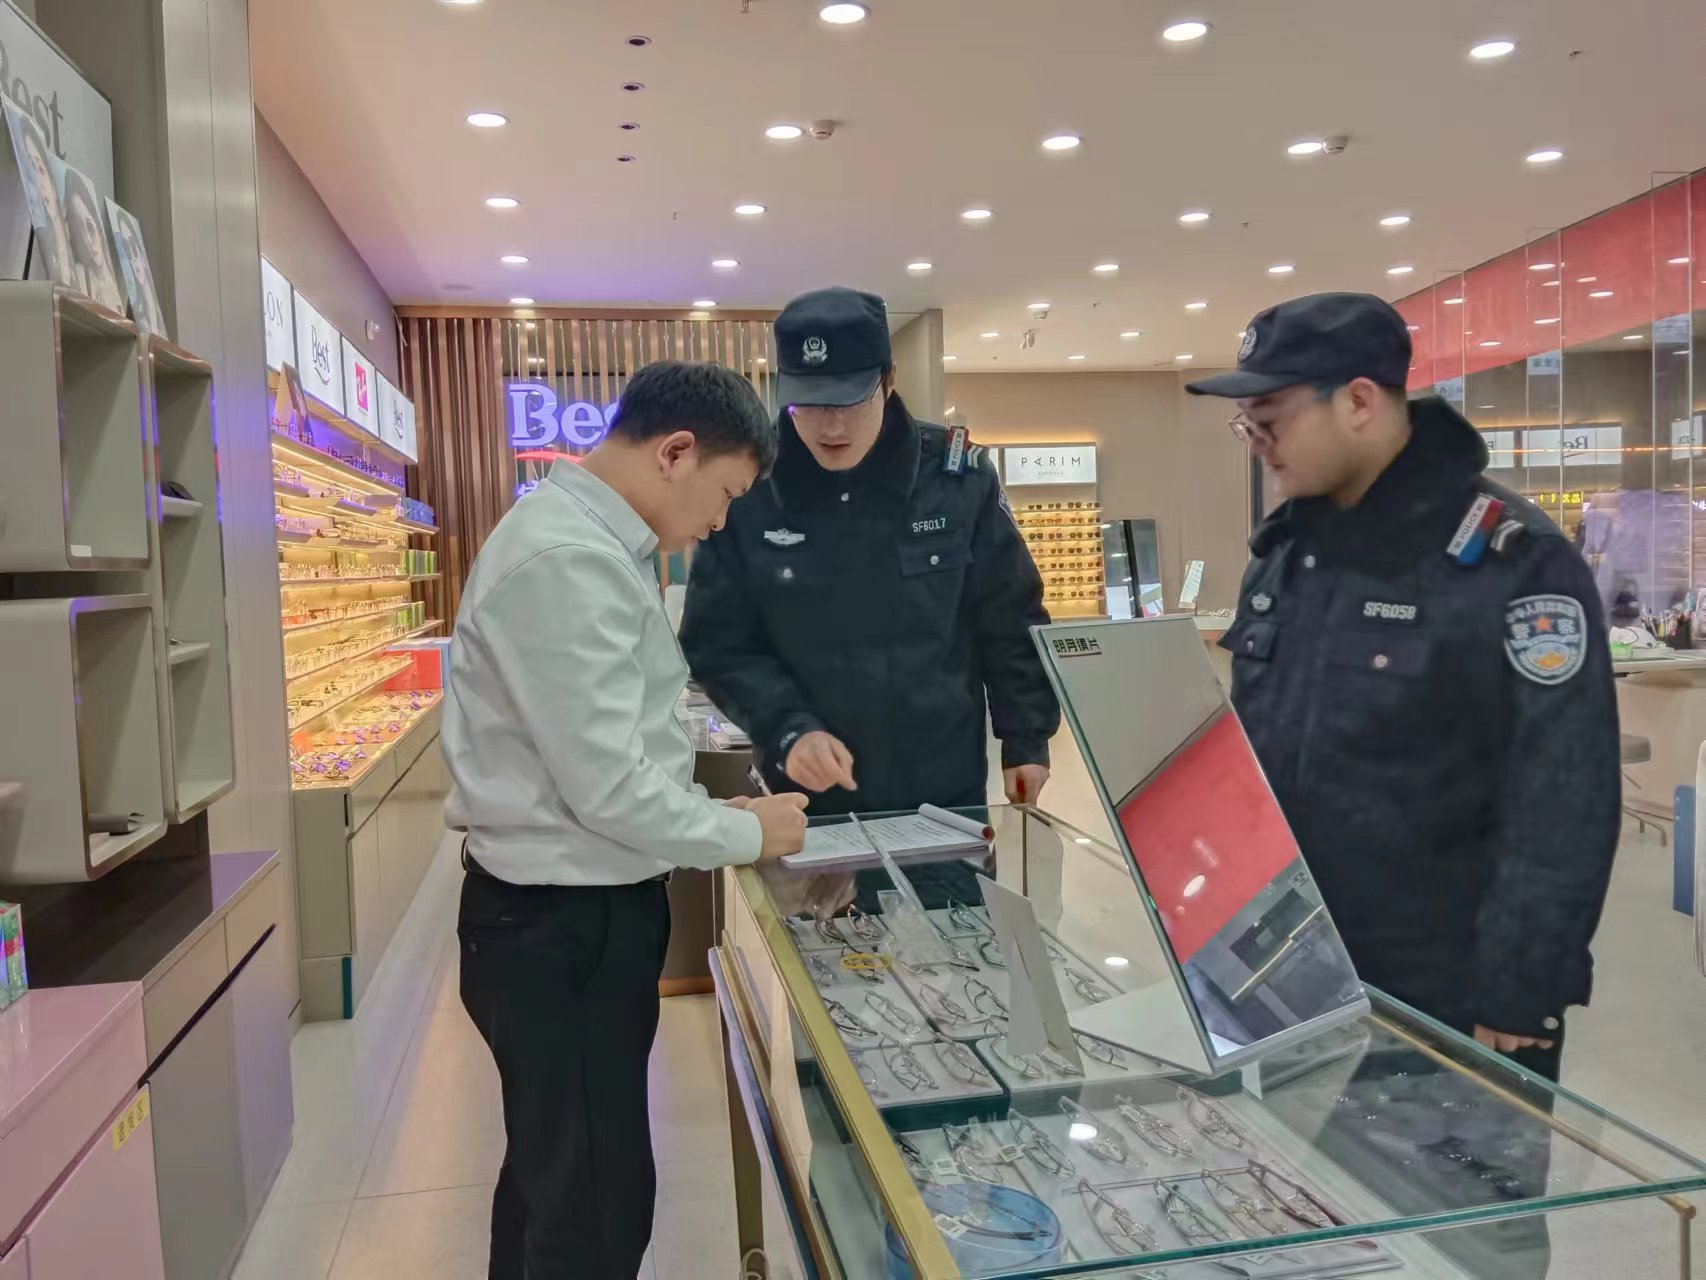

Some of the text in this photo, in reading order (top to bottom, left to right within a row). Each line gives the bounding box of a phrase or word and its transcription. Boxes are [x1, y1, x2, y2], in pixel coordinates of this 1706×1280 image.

[311, 324, 330, 374] Best
[1021, 457, 1081, 468] PARIM
[912, 517, 946, 532] SF6017
